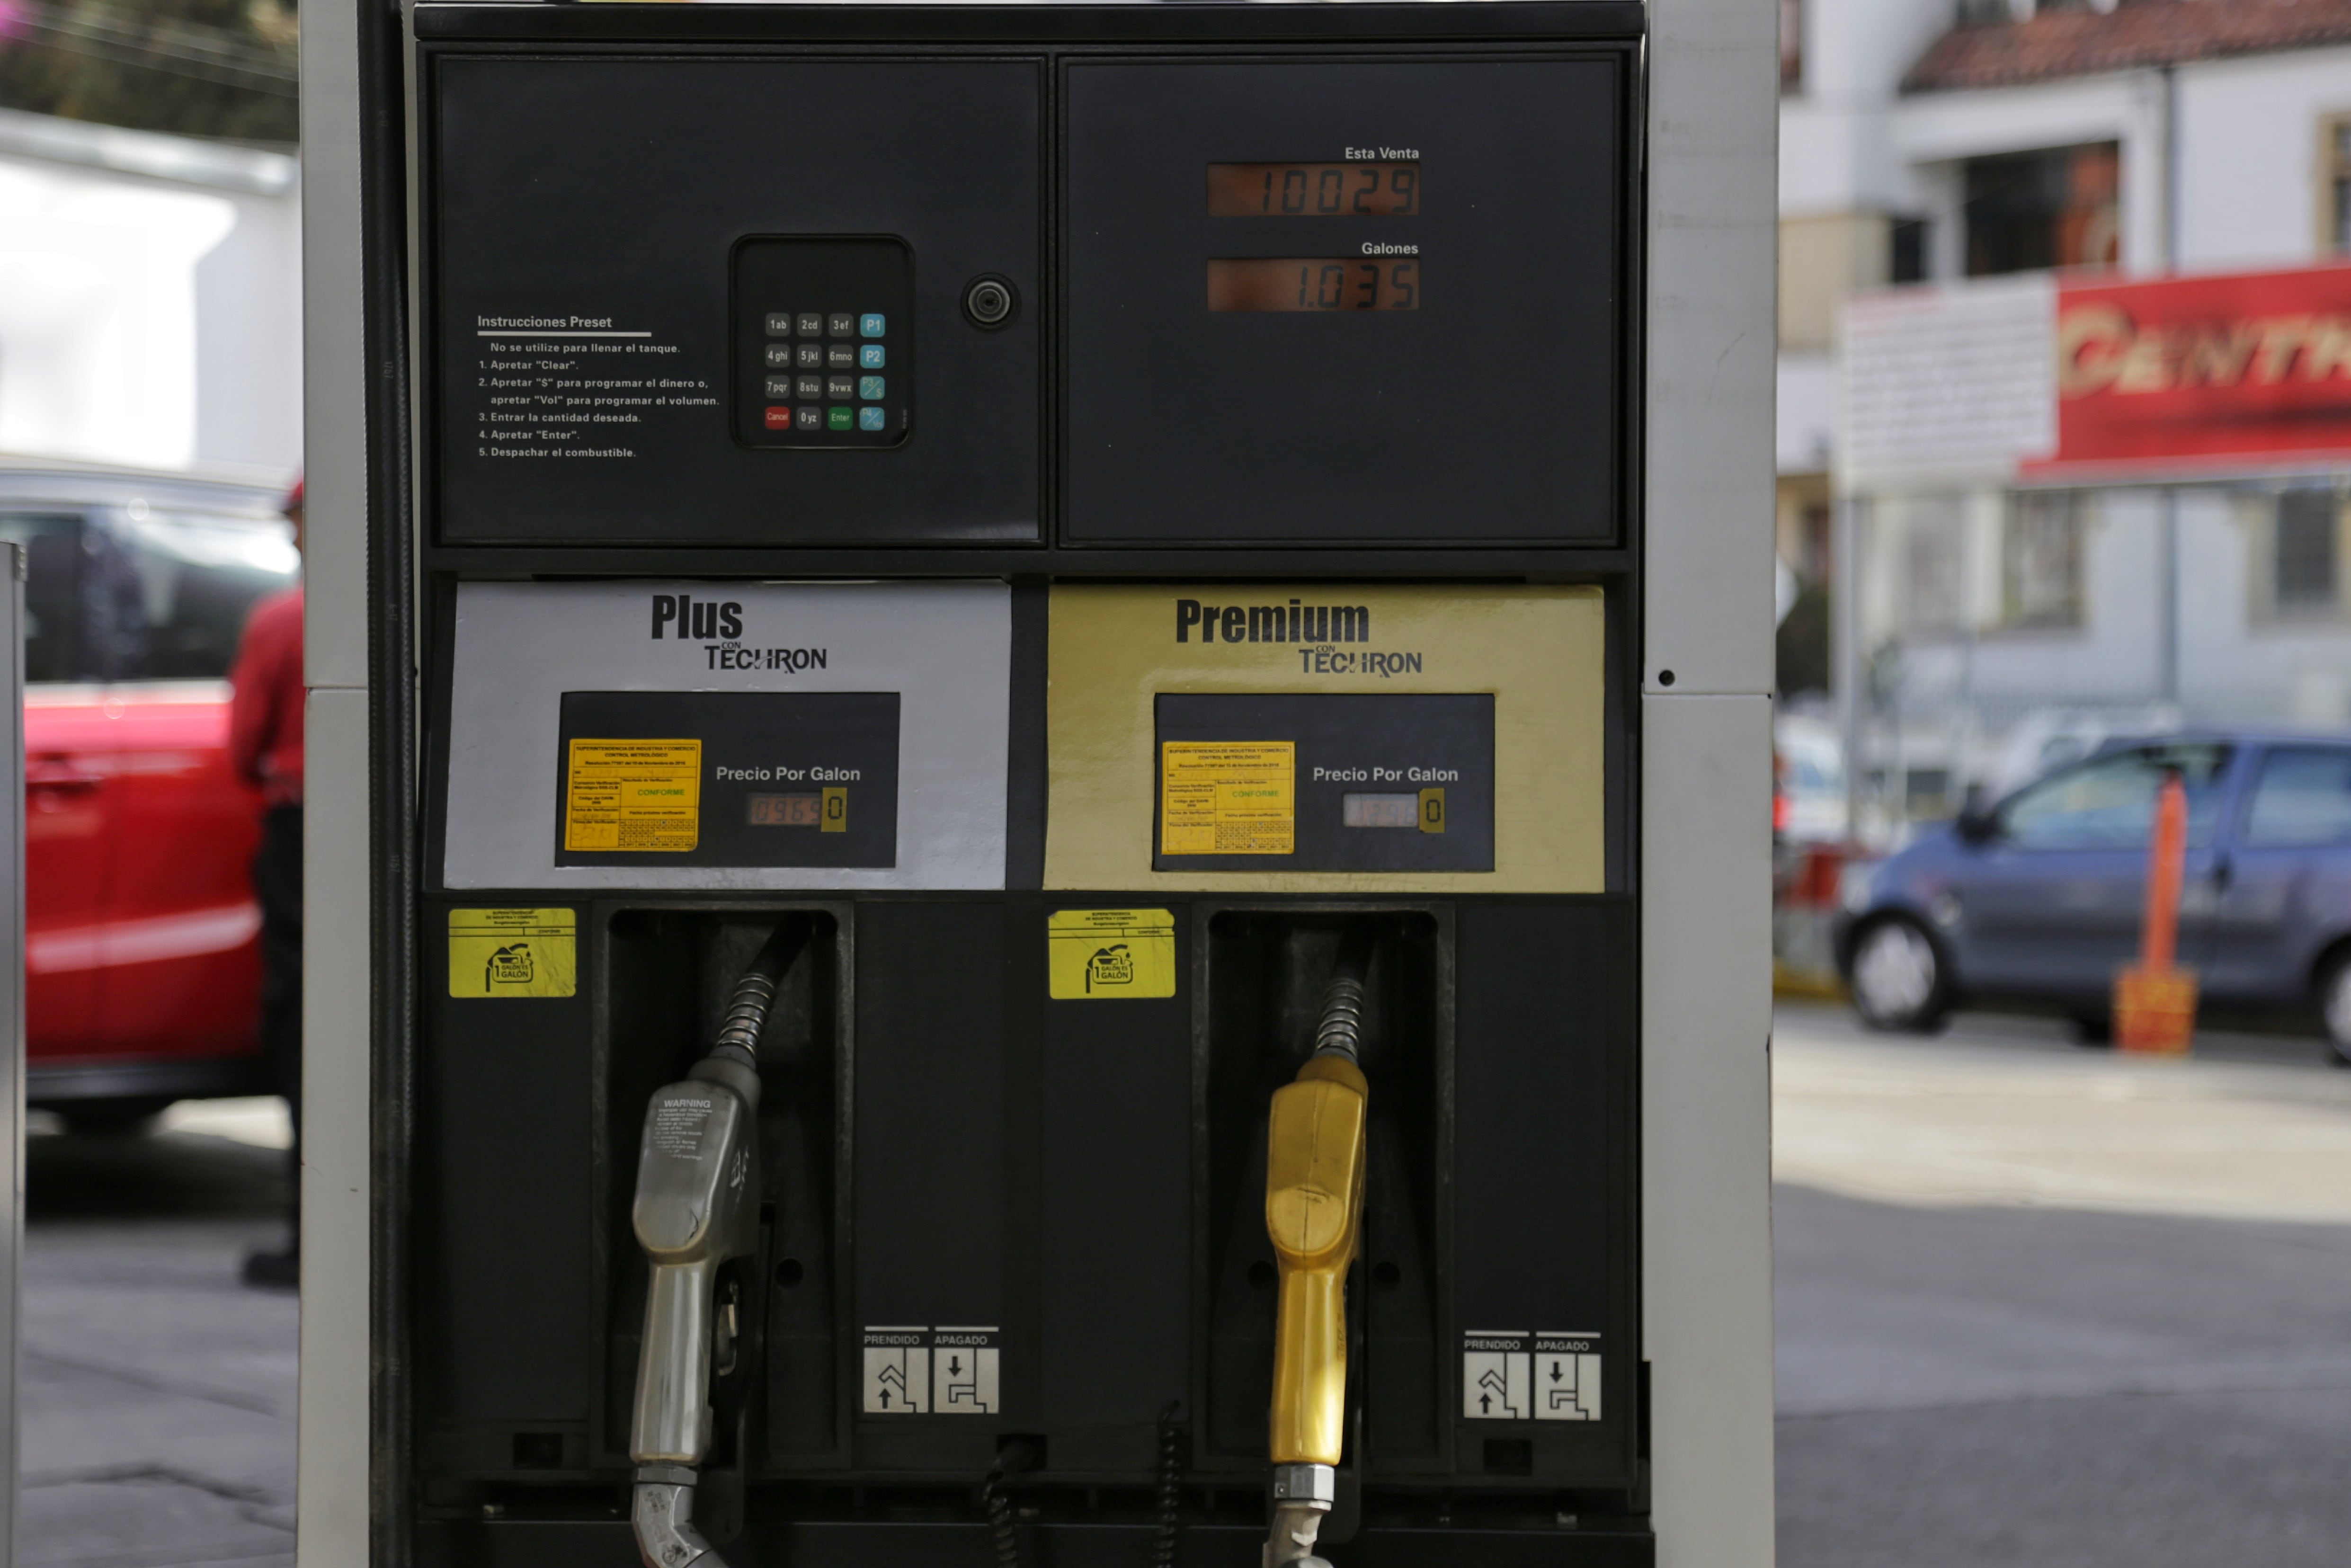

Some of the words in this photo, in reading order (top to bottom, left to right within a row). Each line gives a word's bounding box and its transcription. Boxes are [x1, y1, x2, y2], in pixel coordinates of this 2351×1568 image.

[1345, 147, 1374, 159] Esta
[1380, 147, 1419, 159] Venta
[1263, 170, 1415, 213] 10029
[1362, 242, 1418, 254] Galones
[1299, 265, 1414, 307] 1.035
[478, 316, 566, 327] Instrucciones
[570, 316, 612, 327] Preset
[867, 320, 881, 330] P1
[491, 343, 506, 351] No
[526, 343, 559, 352] utilize
[592, 344, 622, 352] llenar
[626, 344, 635, 352] el
[639, 345, 679, 354] tanque.
[866, 351, 880, 362] P2
[491, 360, 532, 370] Apretar
[536, 361, 578, 369] "Clear".
[479, 378, 487, 386] 2.
[491, 378, 532, 388] Apretar
[536, 378, 553, 387] "$"
[585, 381, 642, 389] programar
[646, 379, 655, 387] el
[659, 379, 694, 387] dinero
[863, 378, 873, 386] P3
[491, 397, 530, 405] apretar
[534, 396, 562, 404] "Vol"
[595, 398, 651, 406] programar
[656, 397, 665, 405] el
[669, 397, 719, 405] volumen.
[479, 413, 487, 421] 3.
[491, 413, 525, 421] Entrar
[529, 413, 538, 421] la
[542, 413, 589, 421] cantidad
[593, 414, 641, 422] deseada.
[491, 430, 532, 440] Apretar
[536, 430, 579, 439] "Enter".
[479, 448, 487, 456] 5.
[491, 447, 548, 458] Despachar
[552, 448, 561, 456] el
[566, 448, 635, 457] combustible.
[652, 595, 742, 640] Plus
[1176, 599, 1369, 642] Premium
[704, 646, 827, 674] TECHRON
[1299, 650, 1422, 677] TECHRON
[717, 767, 770, 780] Precio
[776, 767, 805, 780] Por
[810, 767, 860, 780] Galon
[1314, 767, 1367, 781] Precio
[1374, 767, 1402, 781] Por
[1408, 767, 1458, 781] Galon
[495, 966, 499, 977] 1
[1095, 967, 1099, 978] 1
[664, 1099, 710, 1108] WARNING
[864, 1336, 919, 1344] PRENDIDO
[935, 1336, 987, 1345] APAGADO
[1464, 1340, 1520, 1349] PRENDIDO
[1536, 1341, 1589, 1351] APAGADO
